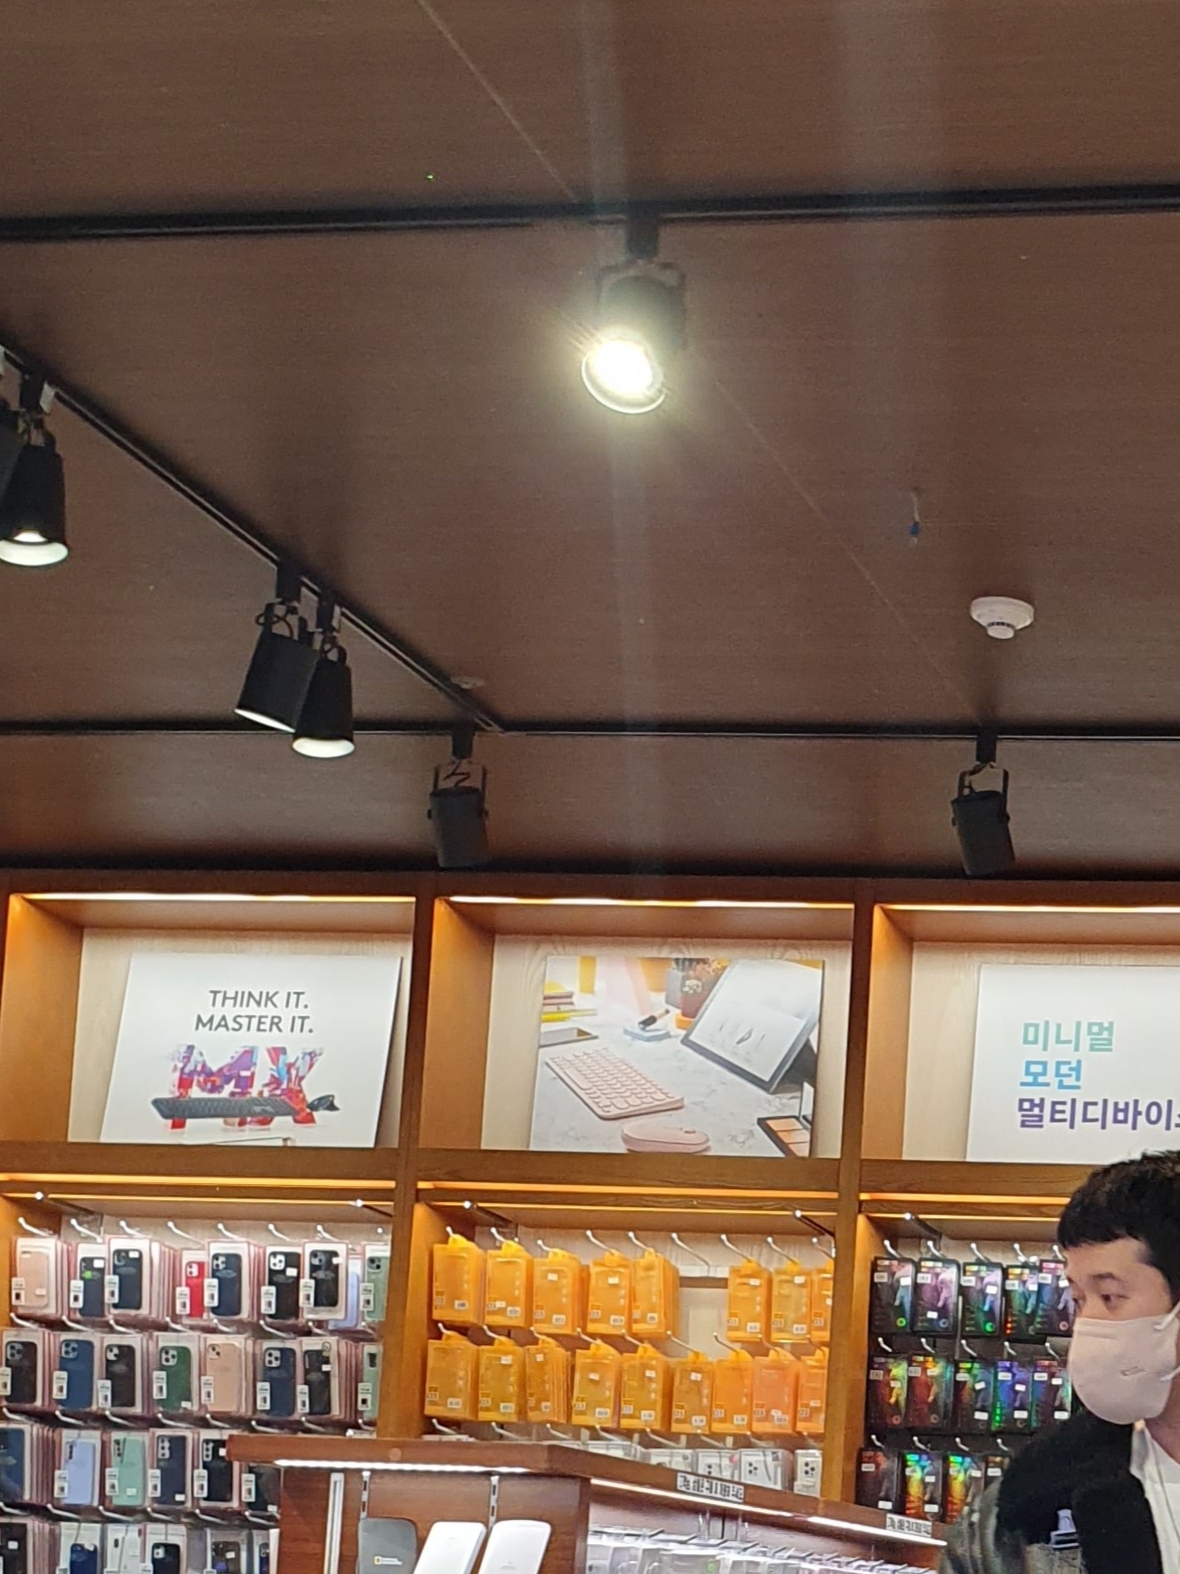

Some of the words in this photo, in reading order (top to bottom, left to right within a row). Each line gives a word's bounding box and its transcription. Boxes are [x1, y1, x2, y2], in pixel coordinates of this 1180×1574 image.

[209, 989, 280, 1008] THINK
[285, 991, 309, 1009] IT.
[194, 1013, 284, 1033] MASTER
[289, 1015, 314, 1034] IT.
[1021, 1019, 1115, 1052] 미니멀
[1019, 1059, 1082, 1090] 모던
